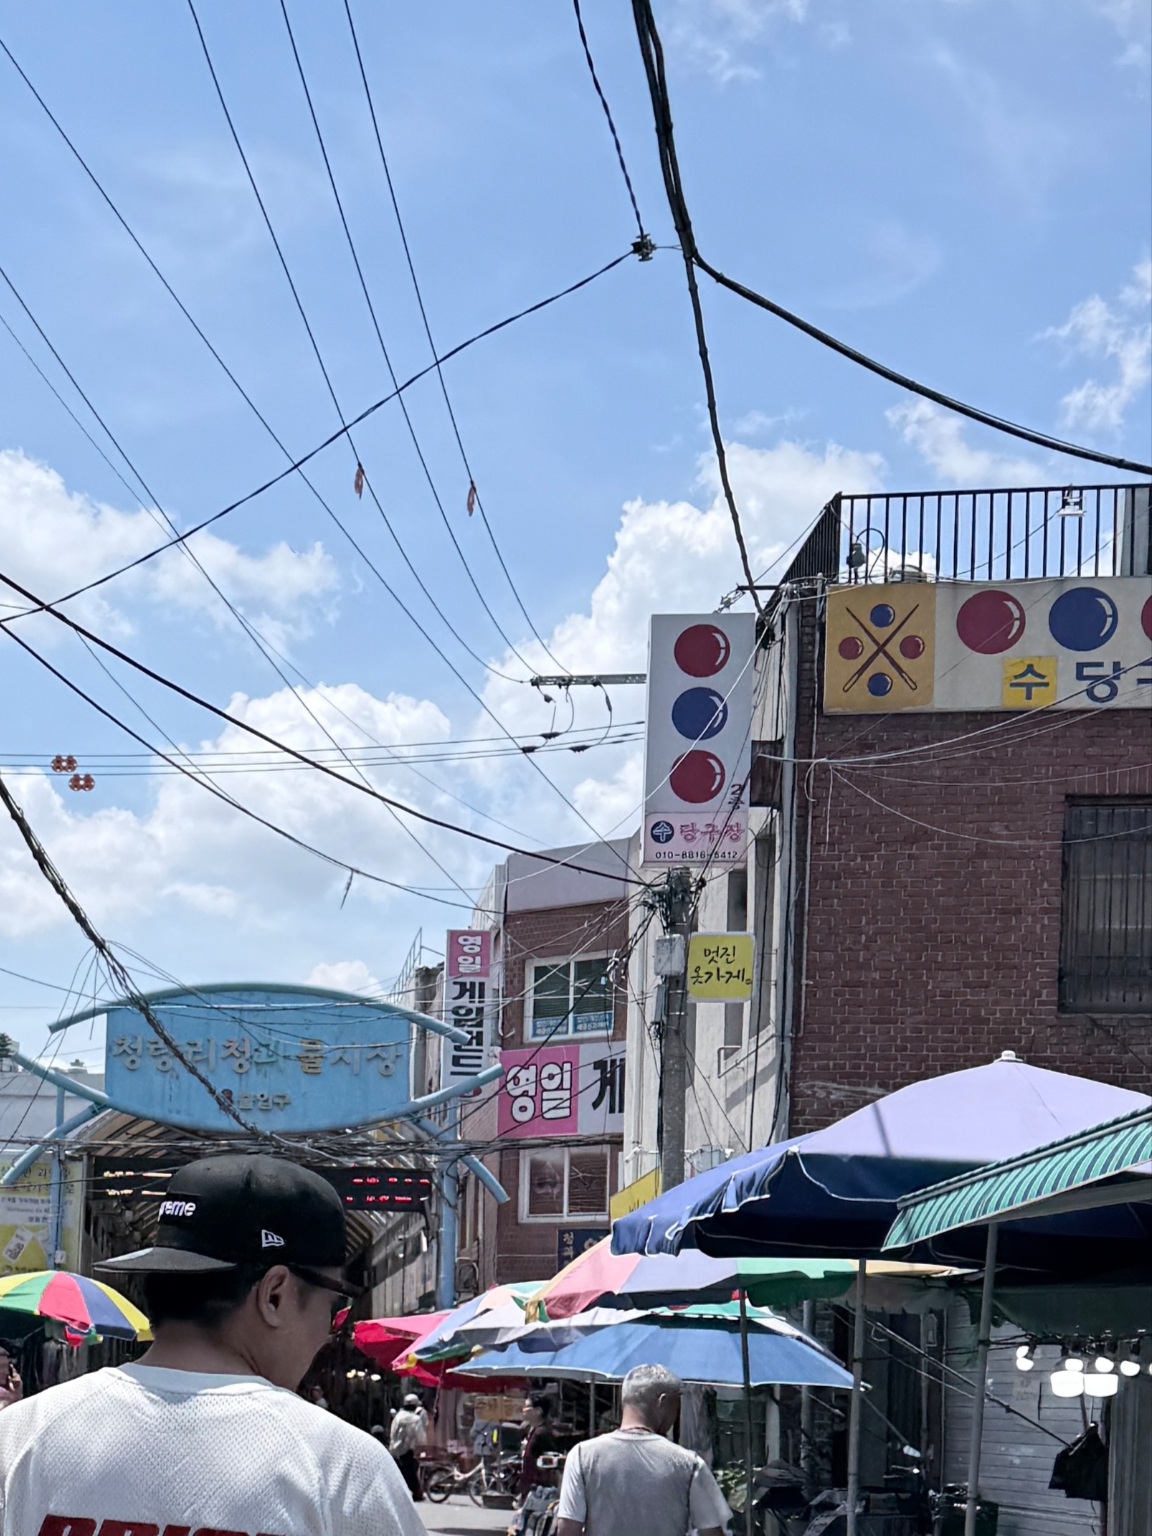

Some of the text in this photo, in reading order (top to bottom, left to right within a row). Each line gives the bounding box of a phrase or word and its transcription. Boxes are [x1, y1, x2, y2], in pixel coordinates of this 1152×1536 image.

[1010, 663, 1050, 701] 수
[679, 821, 745, 843] 당구장
[457, 935, 482, 974] 영일
[703, 945, 736, 965] 멋진
[506, 1061, 573, 1124] 영일
